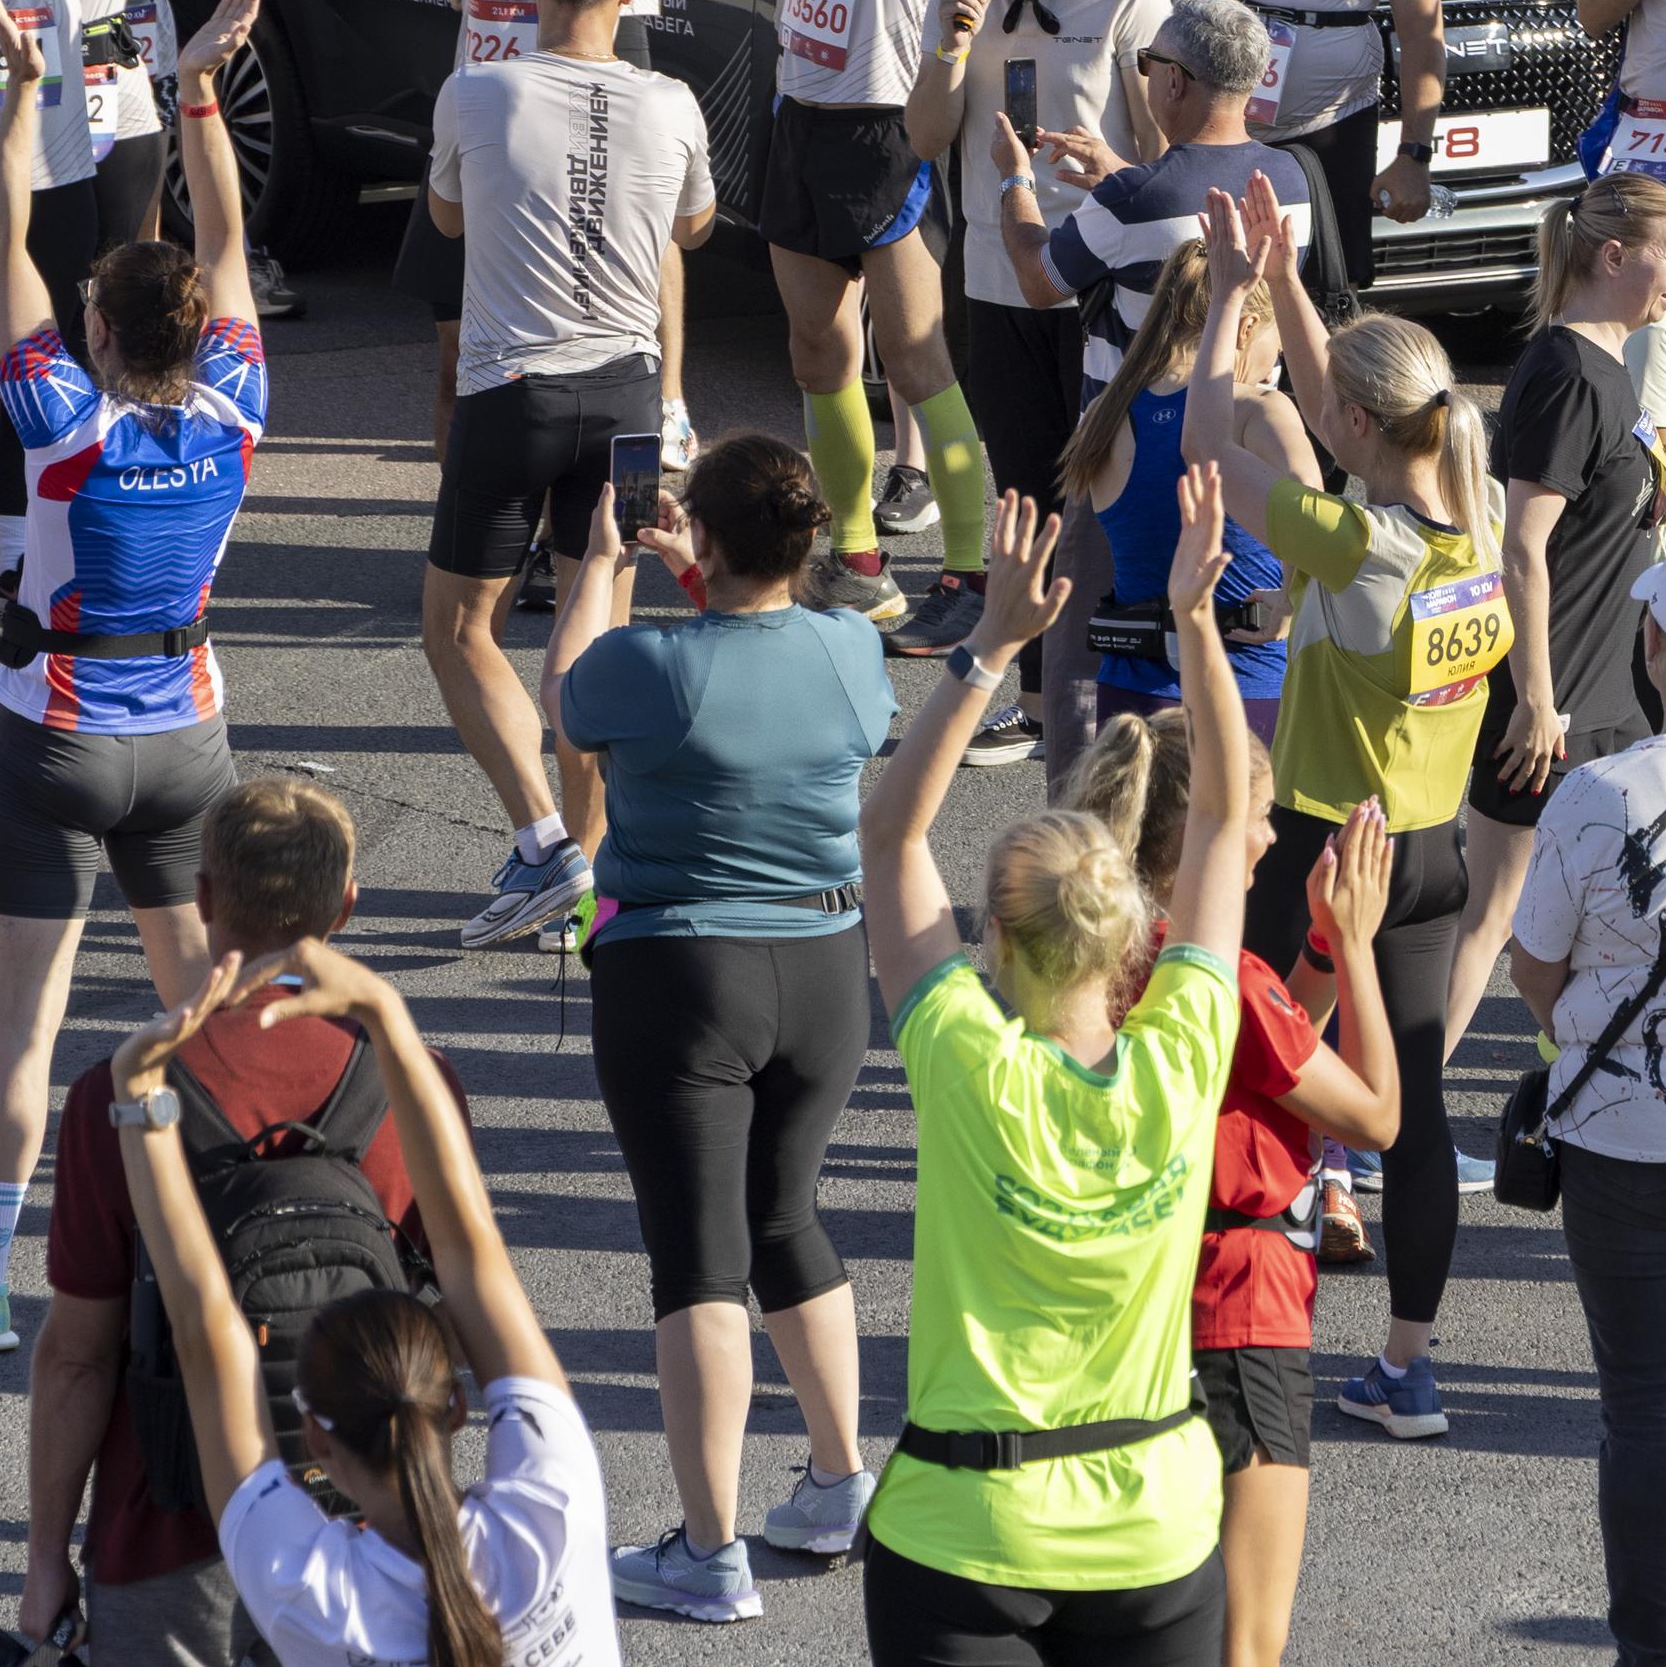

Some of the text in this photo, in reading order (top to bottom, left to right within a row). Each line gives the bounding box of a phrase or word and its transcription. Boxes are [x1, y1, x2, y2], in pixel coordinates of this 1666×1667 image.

[643, 15, 695, 37] АБЕГА
[1052, 36, 1103, 44] TENET
[1445, 36, 1510, 59] NET
[1613, 160, 1624, 171] E
[118, 456, 218, 491] OLESYA
[1469, 584, 1482, 598] 10
[1426, 612, 1501, 667] 8639
[1447, 660, 1476, 677] ЮЛИЯ
